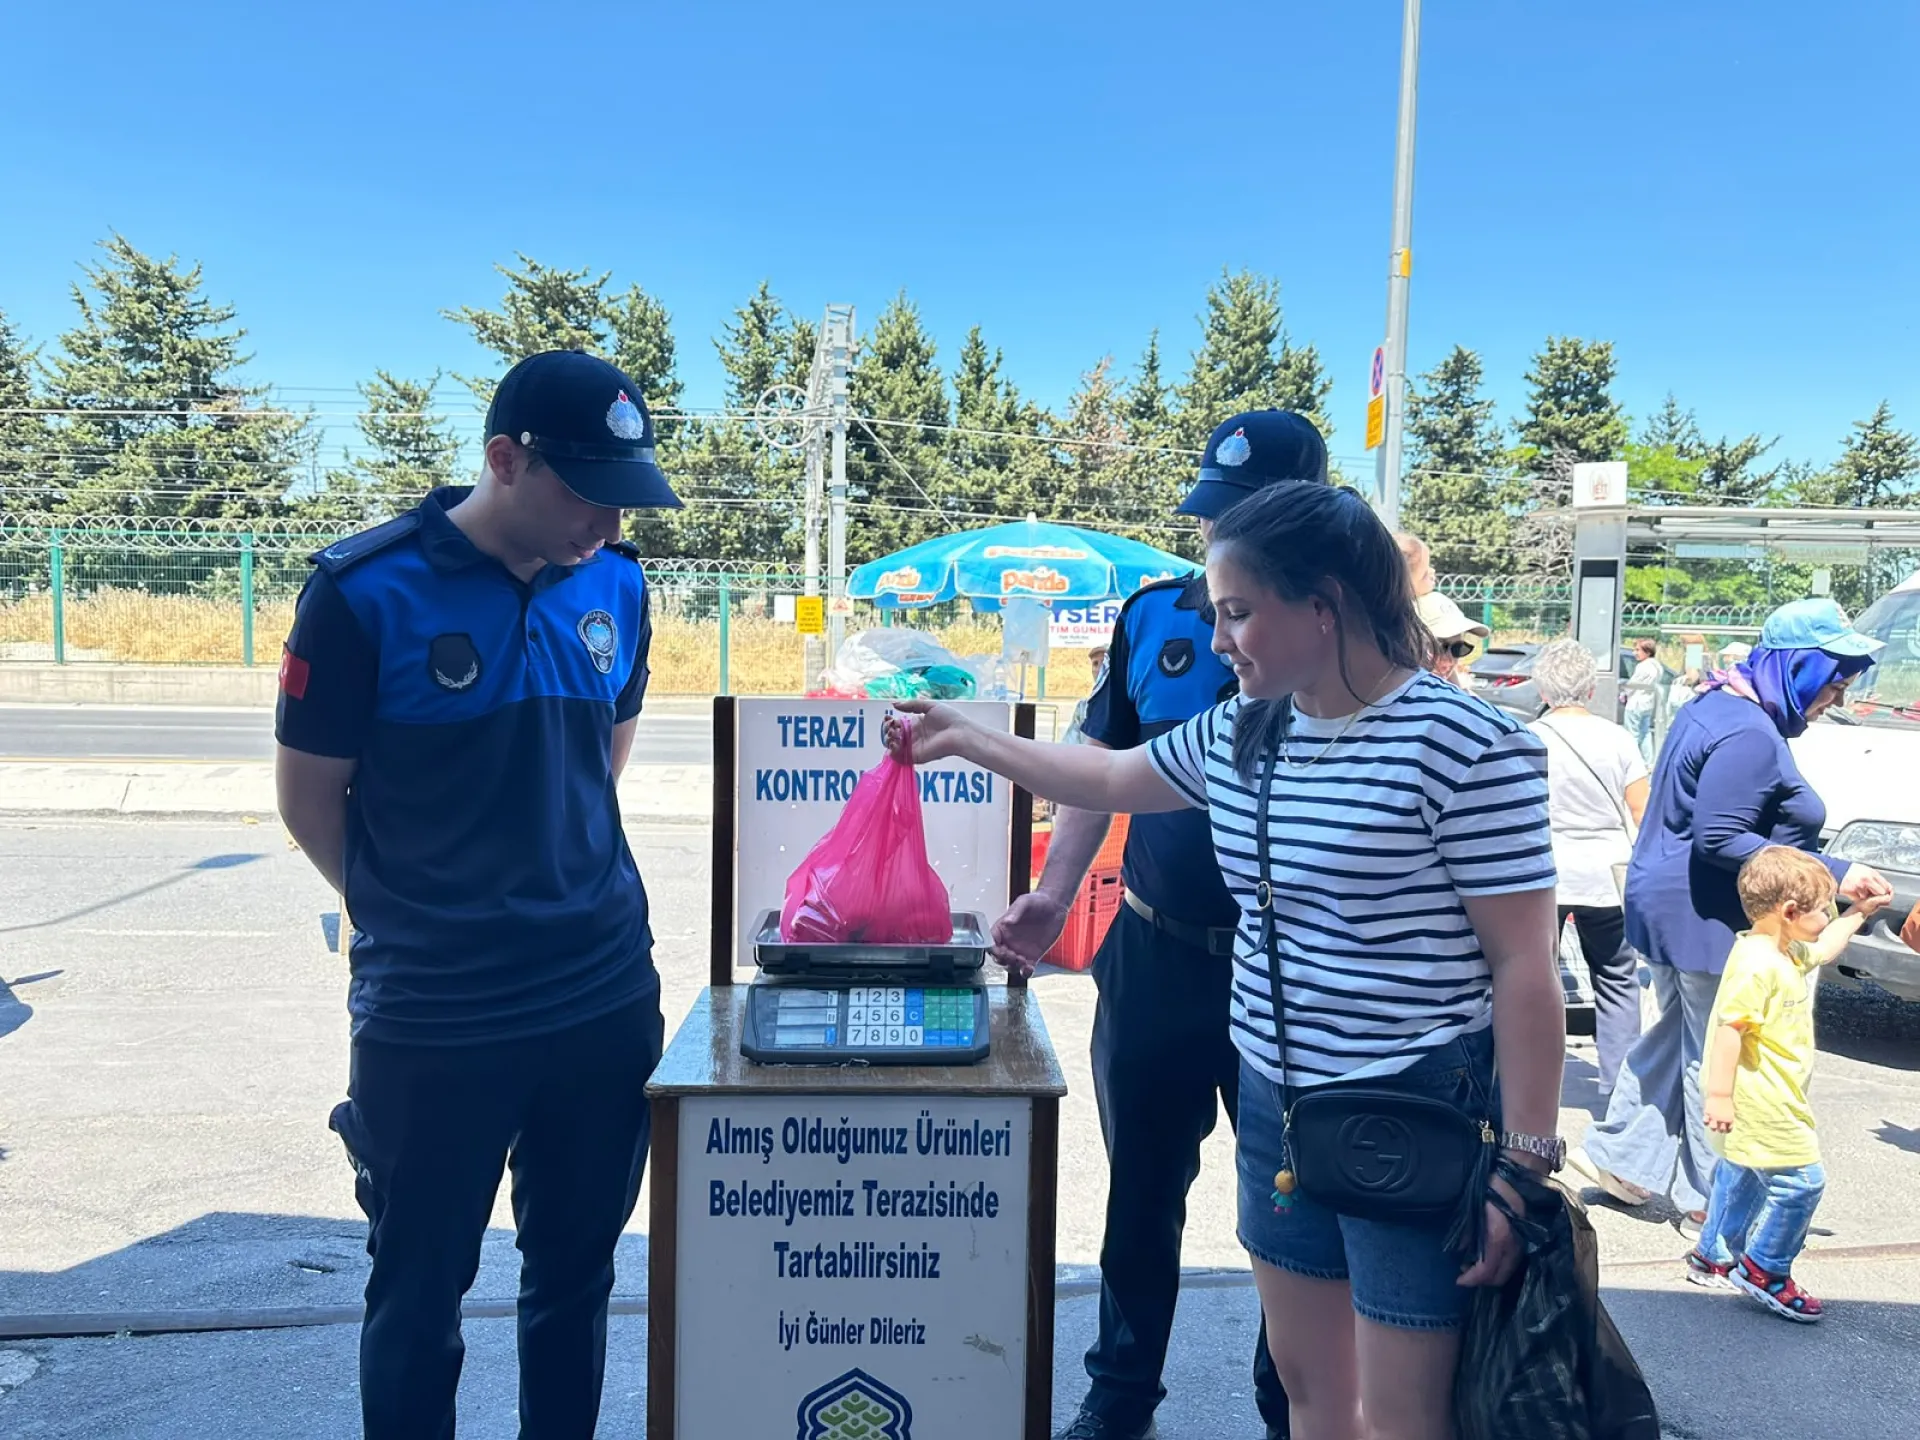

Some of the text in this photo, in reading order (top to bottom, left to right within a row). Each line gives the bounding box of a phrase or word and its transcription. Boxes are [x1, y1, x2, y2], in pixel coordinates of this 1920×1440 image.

[777, 708, 864, 748] TERAZİ
[756, 769, 863, 801] KONTRO
[856, 991, 900, 1002] 1 2 3
[852, 1010, 861, 1021] 4
[872, 1010, 881, 1021] 5
[891, 1010, 900, 1021] 6
[852, 1029, 861, 1041] 7
[871, 1029, 880, 1042] 8
[890, 1029, 899, 1042] 9
[909, 1029, 918, 1042] 0
[706, 1110, 1011, 1164] Almış Olduğunuz Ürünleri
[709, 1180, 999, 1226] Belediyemiz Terazisinde
[774, 1241, 940, 1278] Tartabilirsiniz
[779, 1310, 799, 1351] İyi
[870, 1317, 925, 1344] Dileriz
